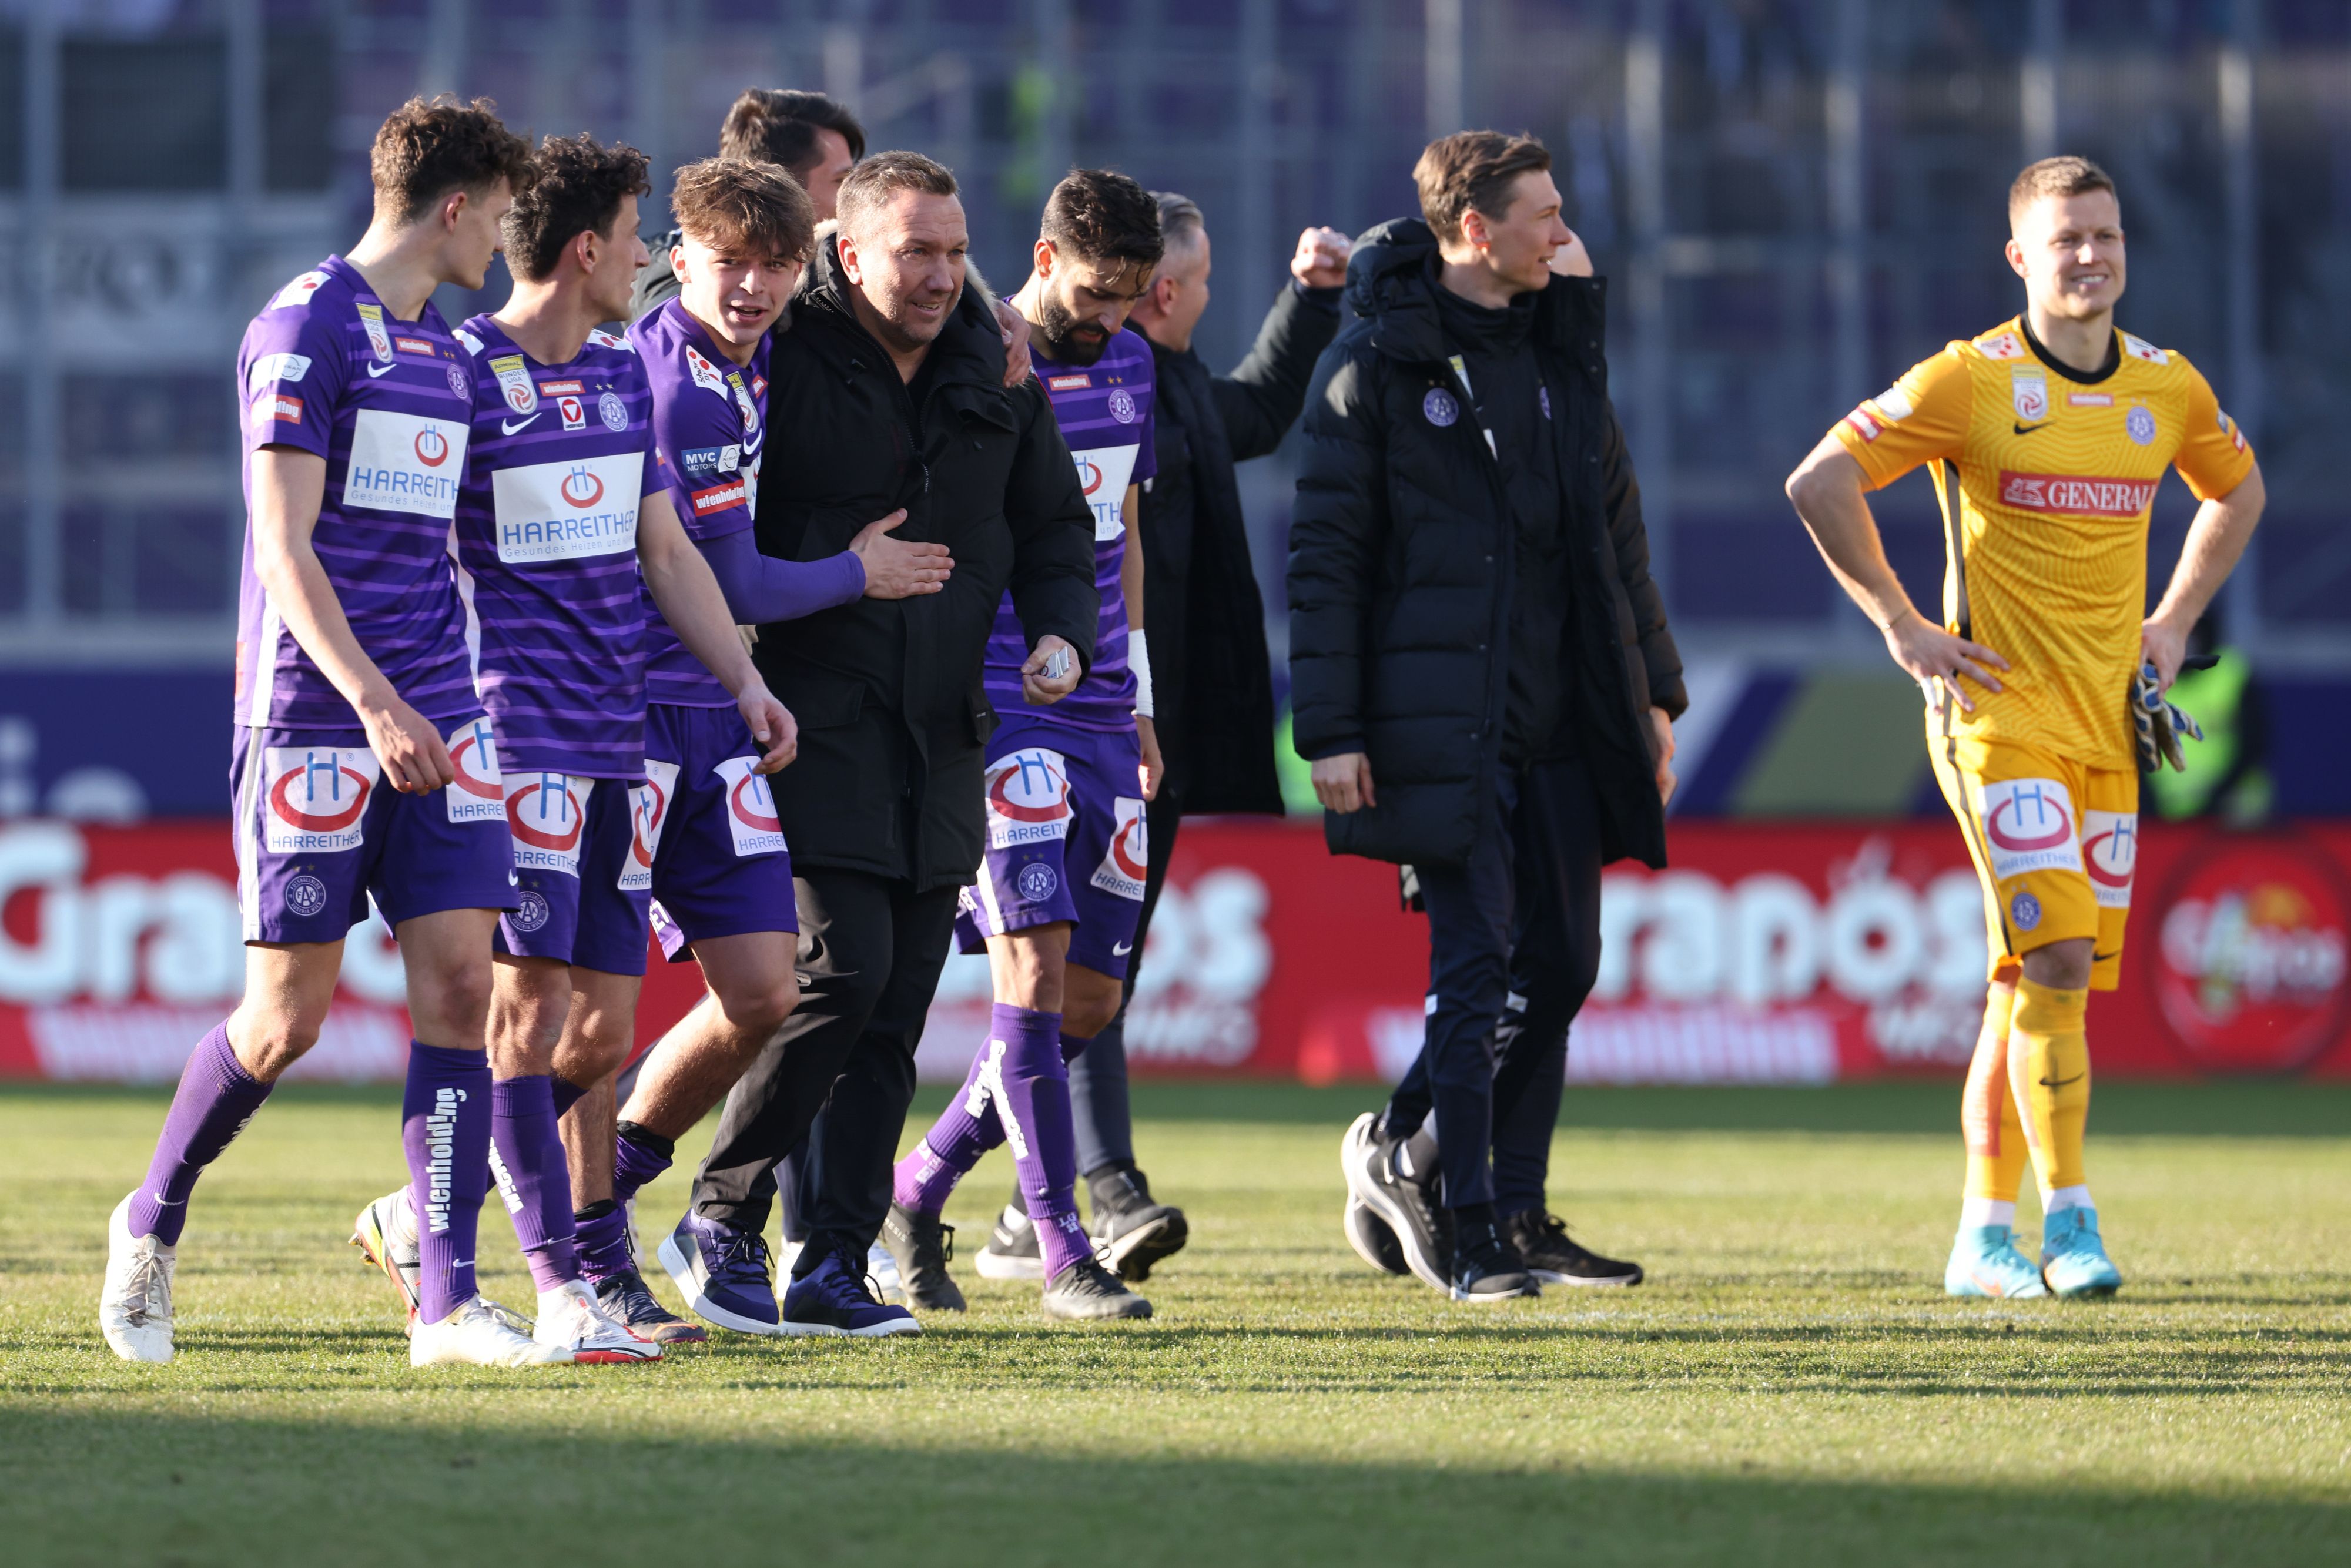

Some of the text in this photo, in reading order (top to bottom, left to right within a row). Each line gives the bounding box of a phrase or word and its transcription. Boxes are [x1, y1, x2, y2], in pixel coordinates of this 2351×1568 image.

[494, 360, 522, 370] ADMIRAL
[498, 370, 526, 379] BUNDES
[685, 452, 716, 464] MVC
[687, 462, 717, 472] MOTORS
[351, 489, 457, 512] Gesundes Heizen un
[503, 510, 635, 546] HARREITHER
[505, 545, 565, 558] Gesundes
[571, 540, 603, 551] Heizen
[606, 538, 621, 547] und
[272, 830, 361, 849] HARREITHER
[514, 850, 579, 873] ARREITHE
